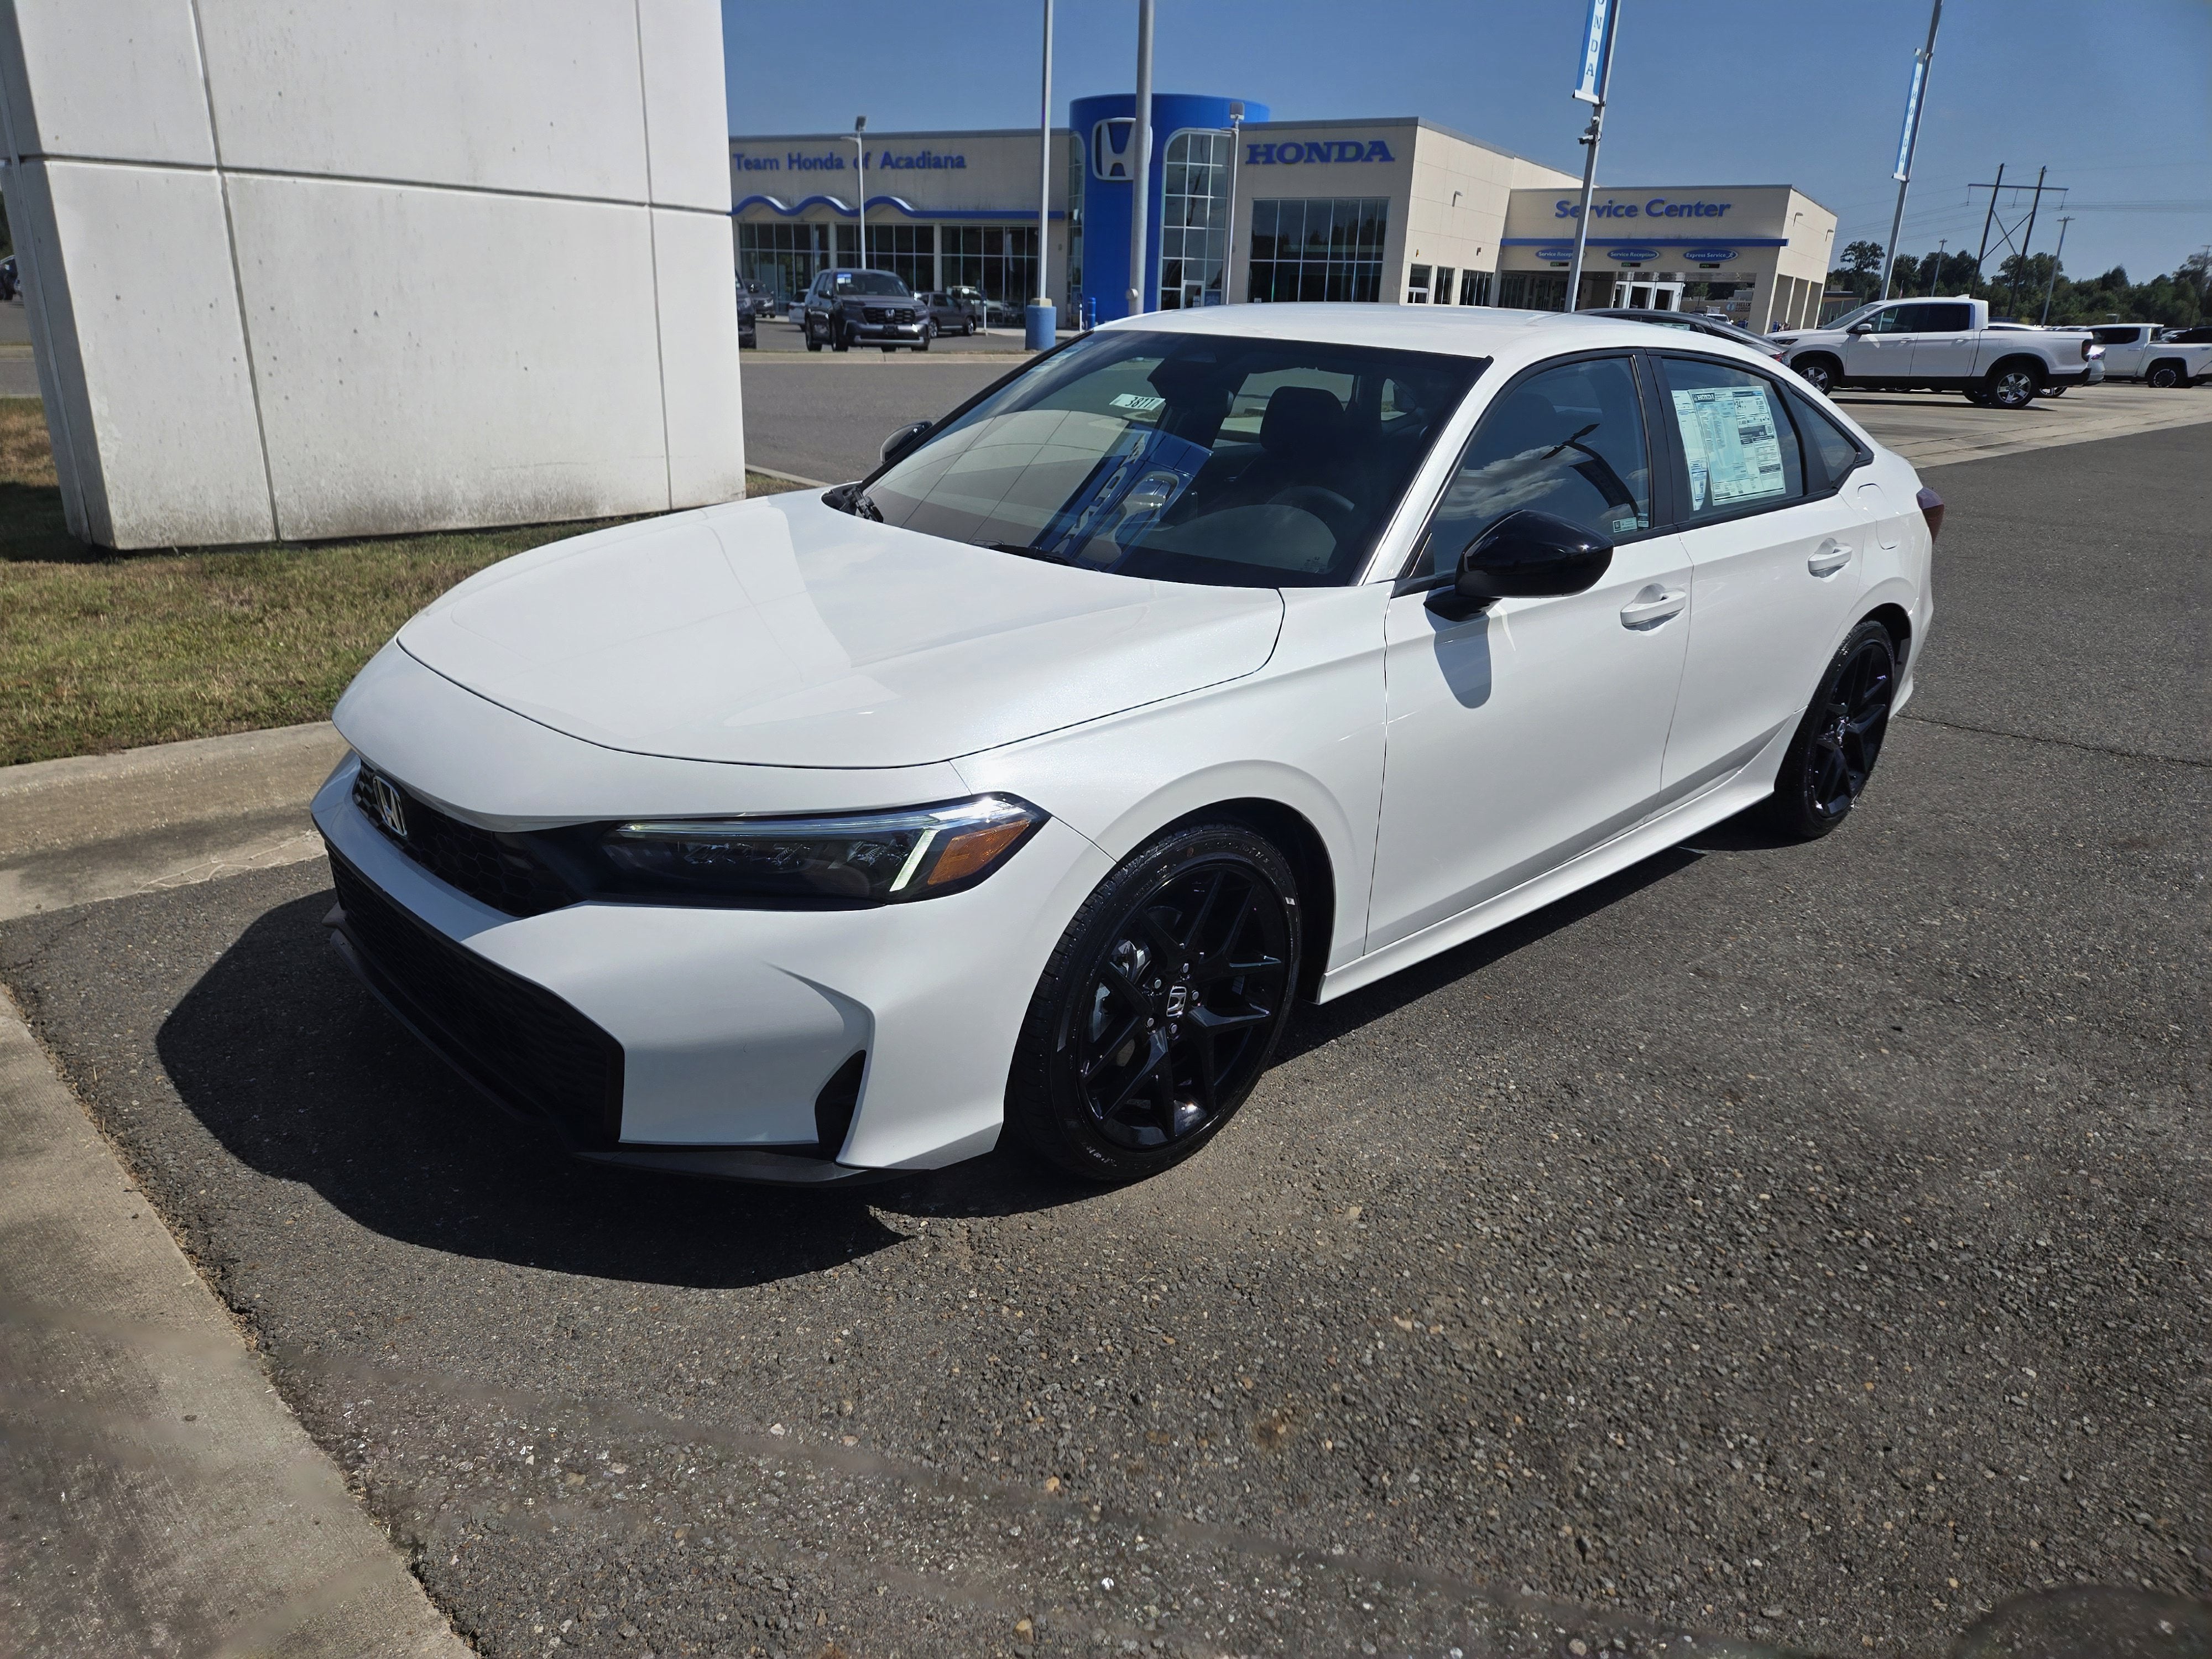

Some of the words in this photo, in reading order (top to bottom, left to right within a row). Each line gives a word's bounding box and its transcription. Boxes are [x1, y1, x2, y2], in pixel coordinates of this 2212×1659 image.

[733, 153, 779, 170] Team
[787, 152, 845, 170] Honda
[880, 150, 967, 169] Acadiana
[1245, 140, 1395, 164] HONDA
[1646, 199, 1731, 217] Center
[1125, 397, 1155, 408] 3811
